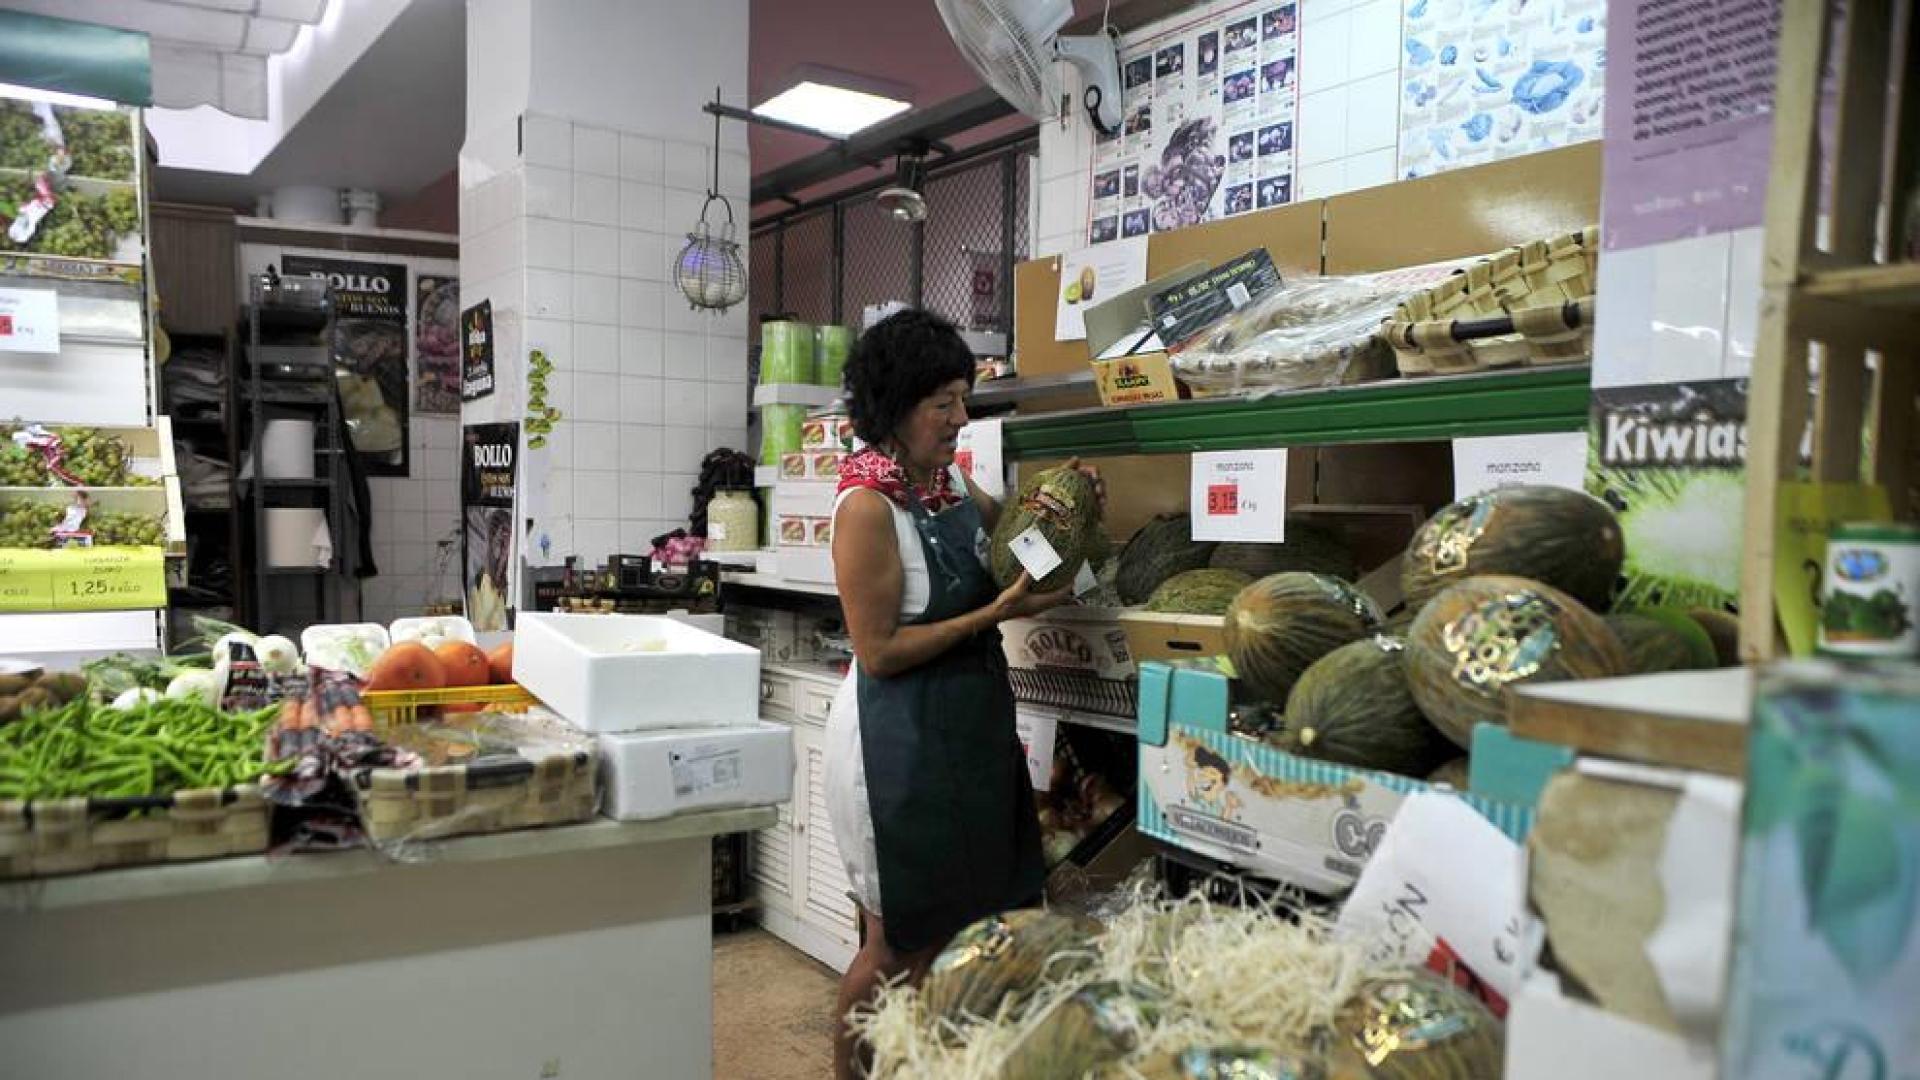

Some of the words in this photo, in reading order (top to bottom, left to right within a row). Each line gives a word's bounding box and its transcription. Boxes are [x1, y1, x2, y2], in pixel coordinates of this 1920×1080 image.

[473, 444, 512, 467] BOLLO
[1215, 461, 1255, 472] manzana
[1486, 462, 1542, 474] manzana
[70, 580, 107, 598] 1,25
[1027, 630, 1093, 664] BOLLO
